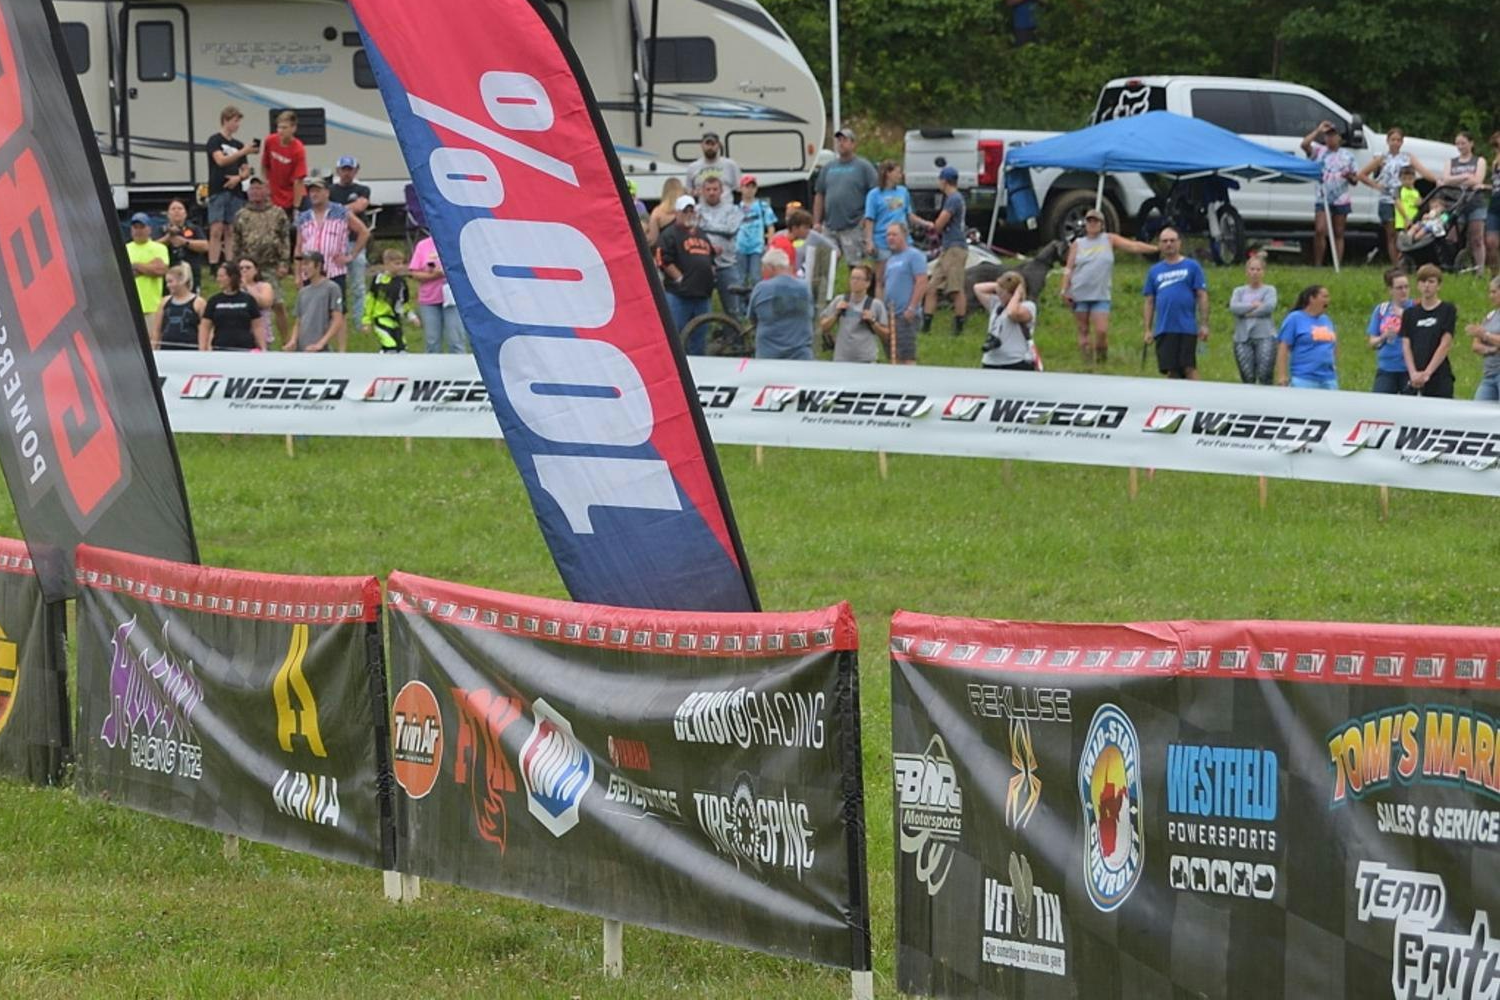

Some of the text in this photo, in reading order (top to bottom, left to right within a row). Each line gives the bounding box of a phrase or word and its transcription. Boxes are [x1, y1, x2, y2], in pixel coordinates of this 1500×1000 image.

[407, 70, 682, 534] 100%
[410, 380, 489, 402] WiSE
[1395, 426, 1500, 457] WiSEC
[745, 691, 825, 749] RACING
[967, 684, 1072, 722] REKLUSE
[130, 733, 177, 774] RACING
[1329, 710, 1419, 801] TOM'S
[1167, 744, 1278, 821] WESTFIELD
[903, 810, 962, 830] Motorsports
[1168, 822, 1276, 851] POWERSPORTS
[1377, 802, 1499, 843] SALES & SERVICE
[985, 878, 1064, 943] VET TIX
[1361, 872, 1441, 919] TEAM
